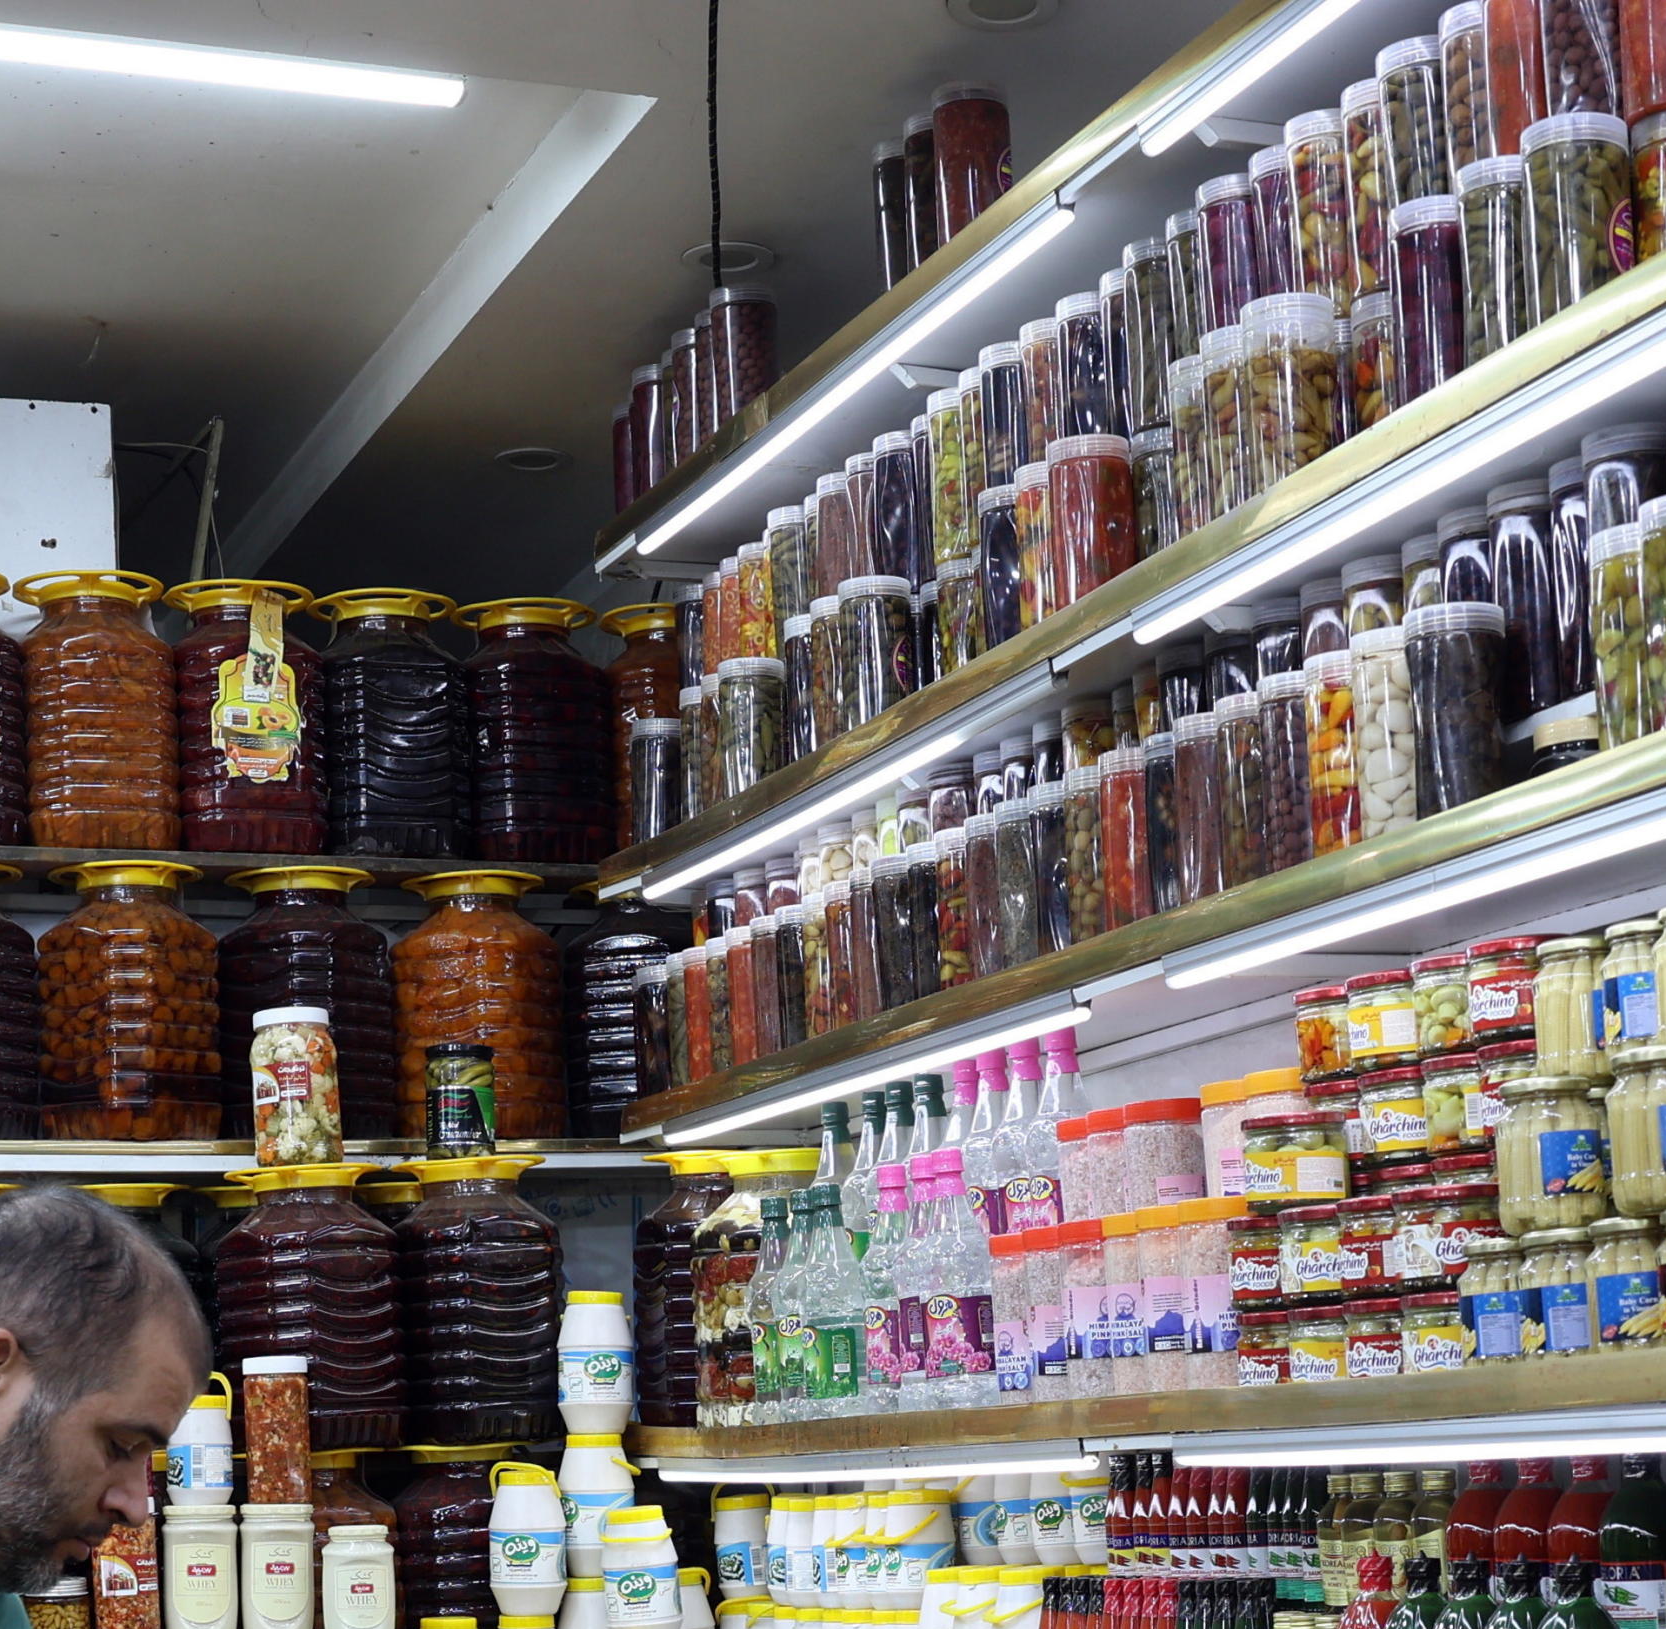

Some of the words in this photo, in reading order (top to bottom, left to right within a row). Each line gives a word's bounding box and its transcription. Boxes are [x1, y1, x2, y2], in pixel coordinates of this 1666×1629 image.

[1402, 1130, 1427, 1139] FOODS
[587, 1355, 622, 1376] وینه
[1036, 1502, 1061, 1521] وینه
[504, 1537, 538, 1557] وینه
[187, 1578, 217, 1591] WHEY
[265, 1576, 295, 1588] WHEY
[620, 1573, 653, 1594] وینه
[345, 1594, 381, 1607] WHEY
